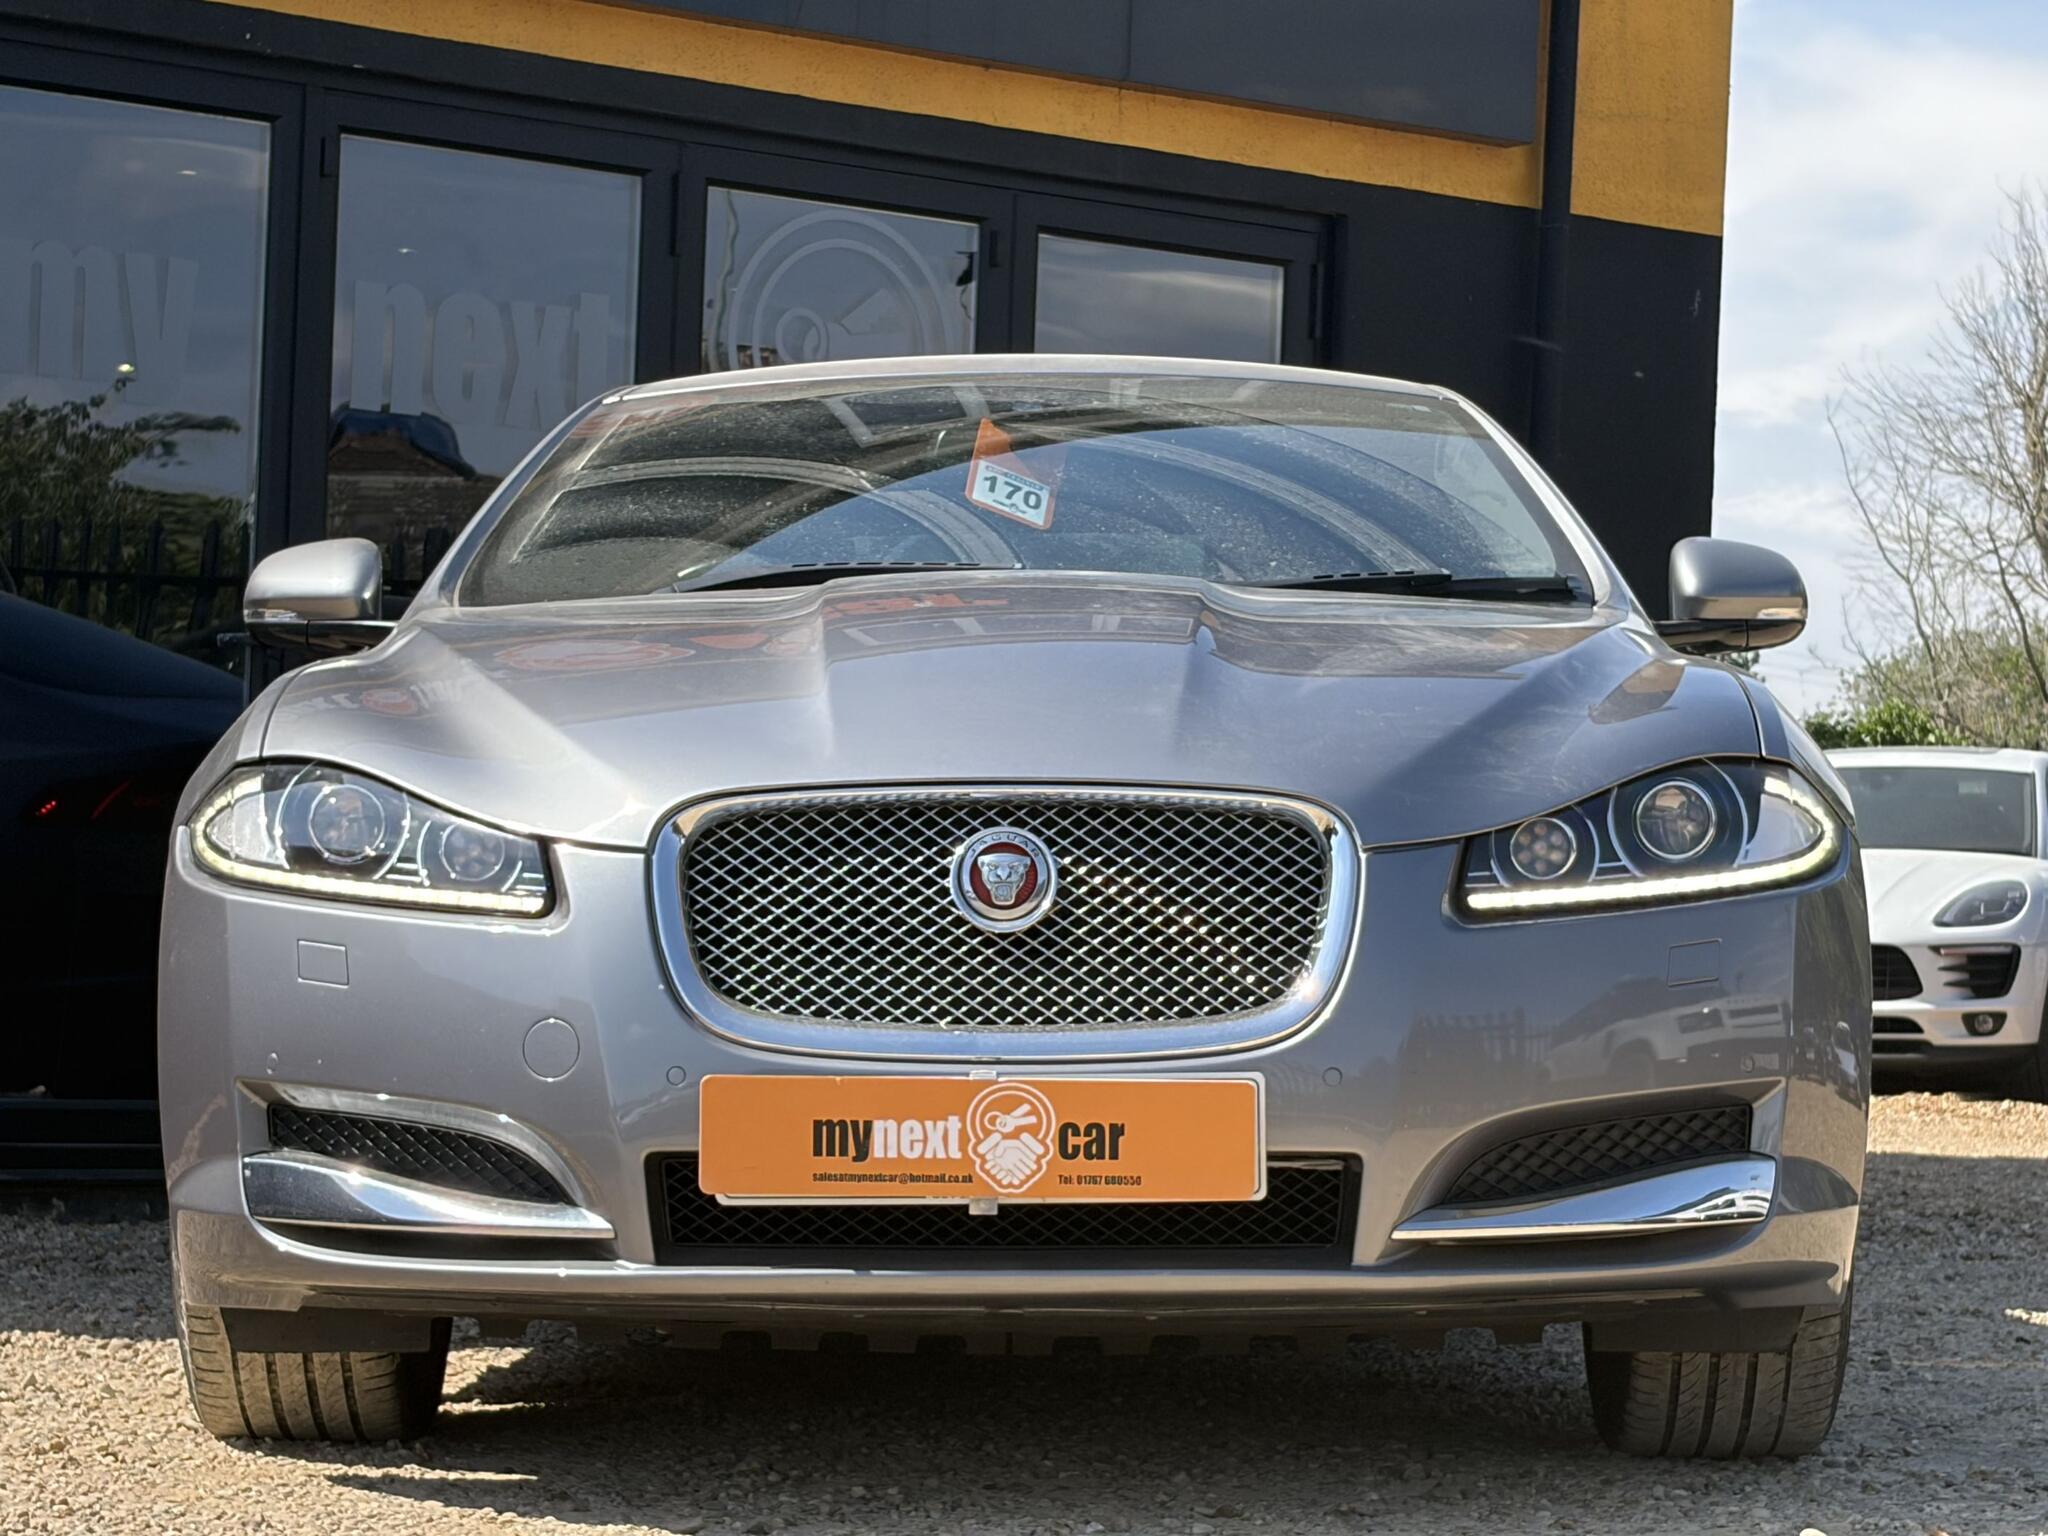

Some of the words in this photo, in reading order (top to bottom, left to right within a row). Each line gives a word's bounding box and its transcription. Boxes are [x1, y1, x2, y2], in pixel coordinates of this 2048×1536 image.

[0, 239, 199, 404] my
[349, 279, 611, 432] next
[983, 475, 1042, 510] 170
[969, 834, 1040, 858] JAGUAR
[812, 1115, 962, 1162] mynext
[1058, 1122, 1125, 1160] car
